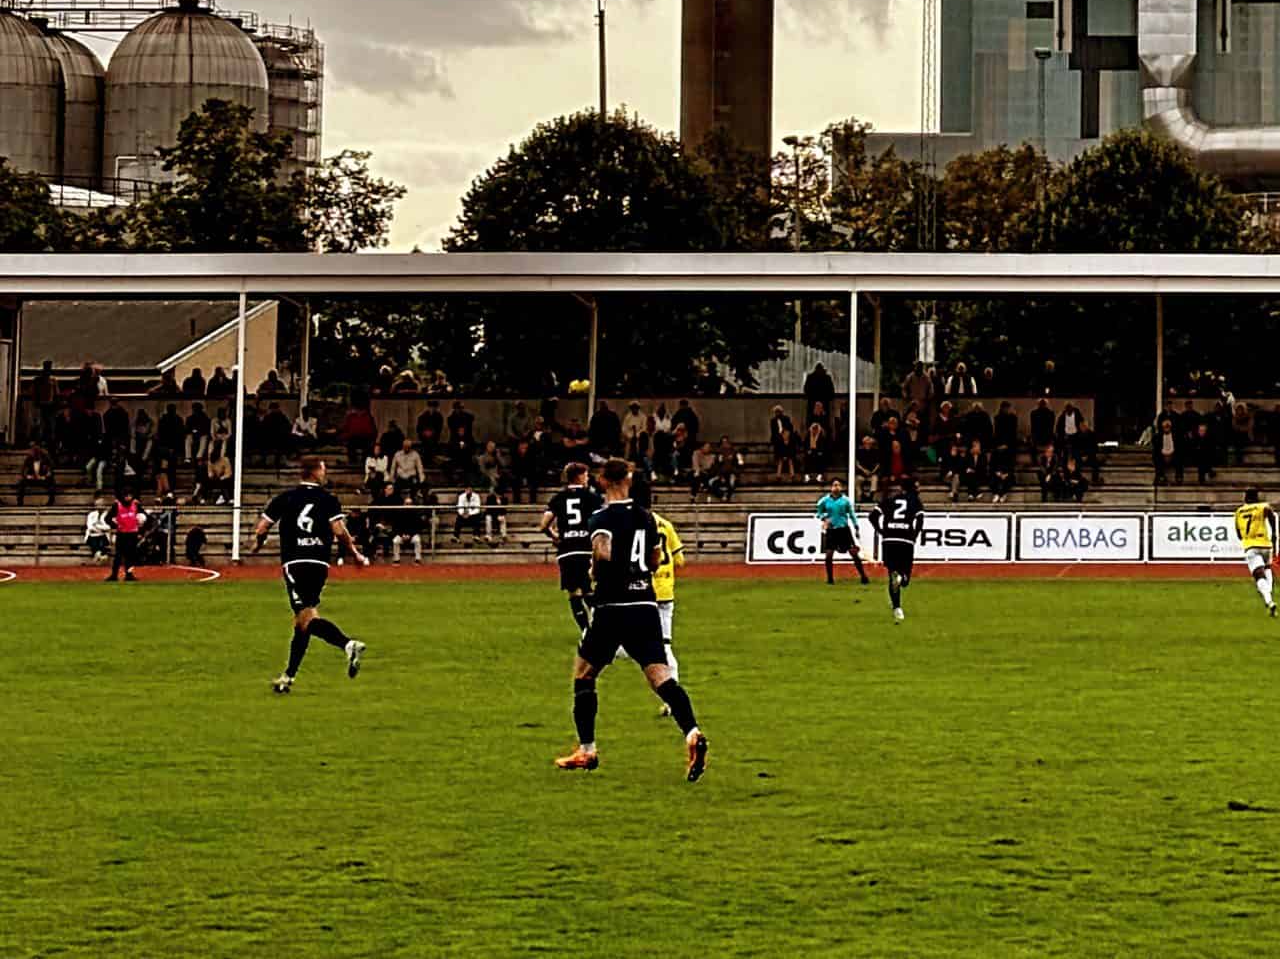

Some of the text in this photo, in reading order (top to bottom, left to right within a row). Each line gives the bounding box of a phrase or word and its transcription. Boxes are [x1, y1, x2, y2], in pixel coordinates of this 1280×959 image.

[297, 503, 314, 533] 6
[566, 498, 582, 525] 5
[893, 499, 907, 519] 2
[920, 529, 992, 547] RSA
[1033, 528, 1127, 548] BRABAG
[1167, 521, 1229, 541] akea
[631, 529, 649, 571] 4
